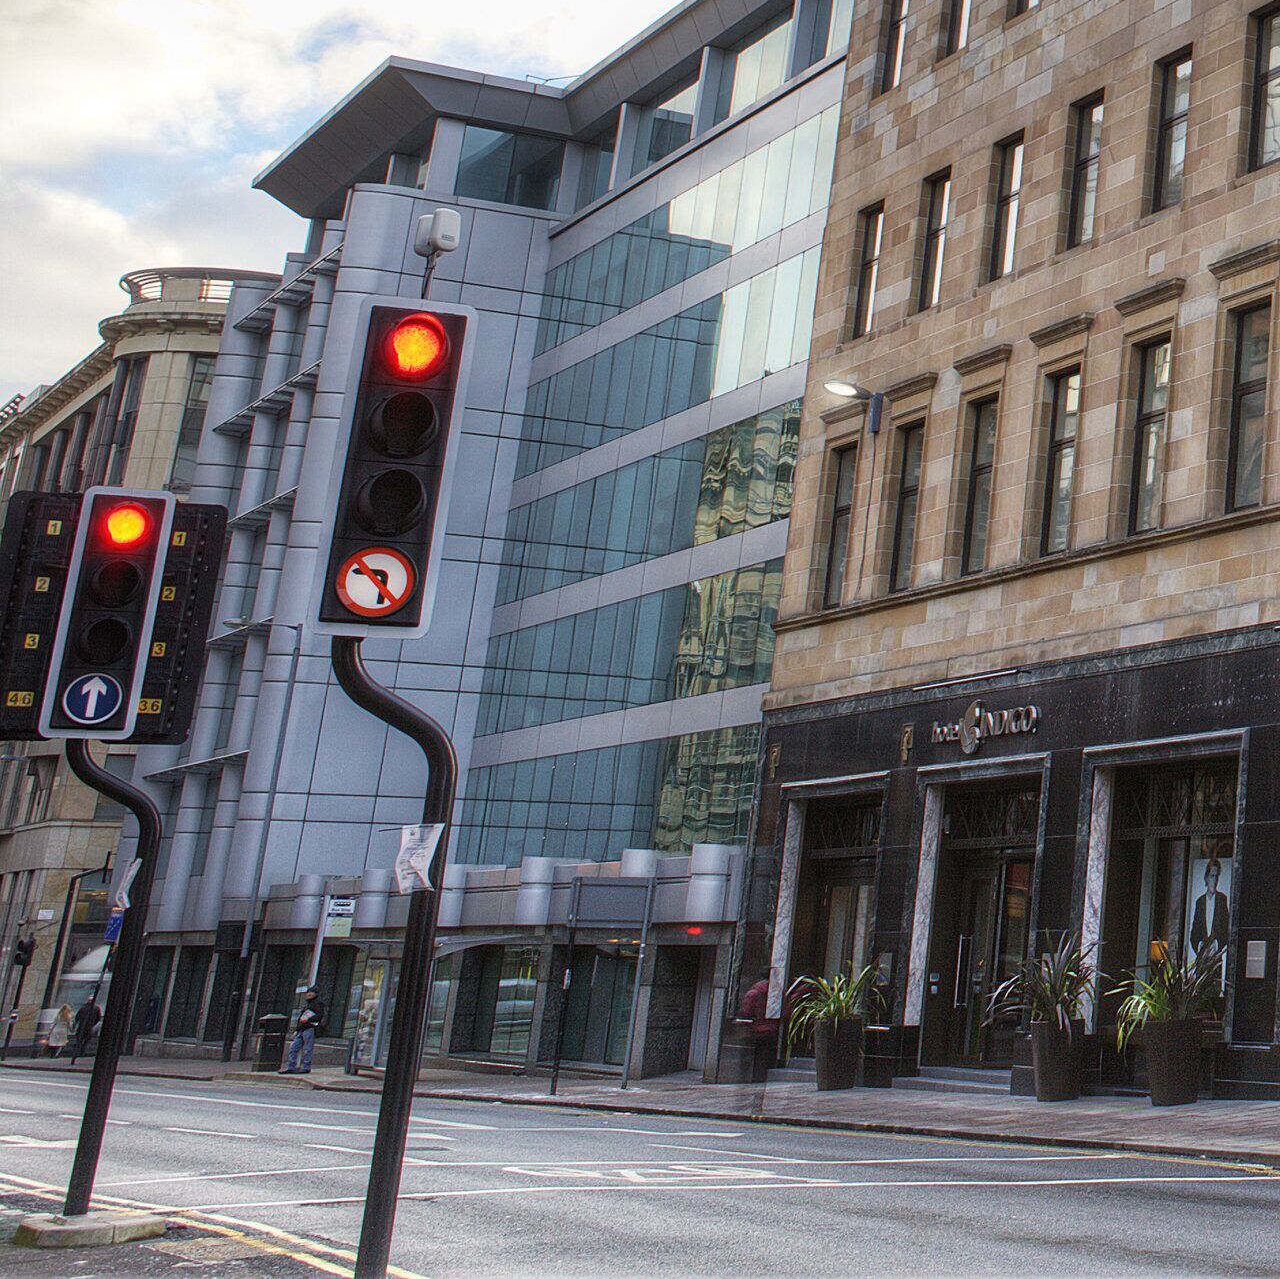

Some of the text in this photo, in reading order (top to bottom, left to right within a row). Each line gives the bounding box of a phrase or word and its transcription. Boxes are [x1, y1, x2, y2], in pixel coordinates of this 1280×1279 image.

[37, 577, 48, 591] 2
[164, 587, 175, 600] 2
[27, 635, 38, 648] 3
[154, 643, 164, 656] 3
[9, 692, 33, 707] 46
[139, 699, 161, 713] 36
[931, 706, 1037, 743] hotel INDIGO
